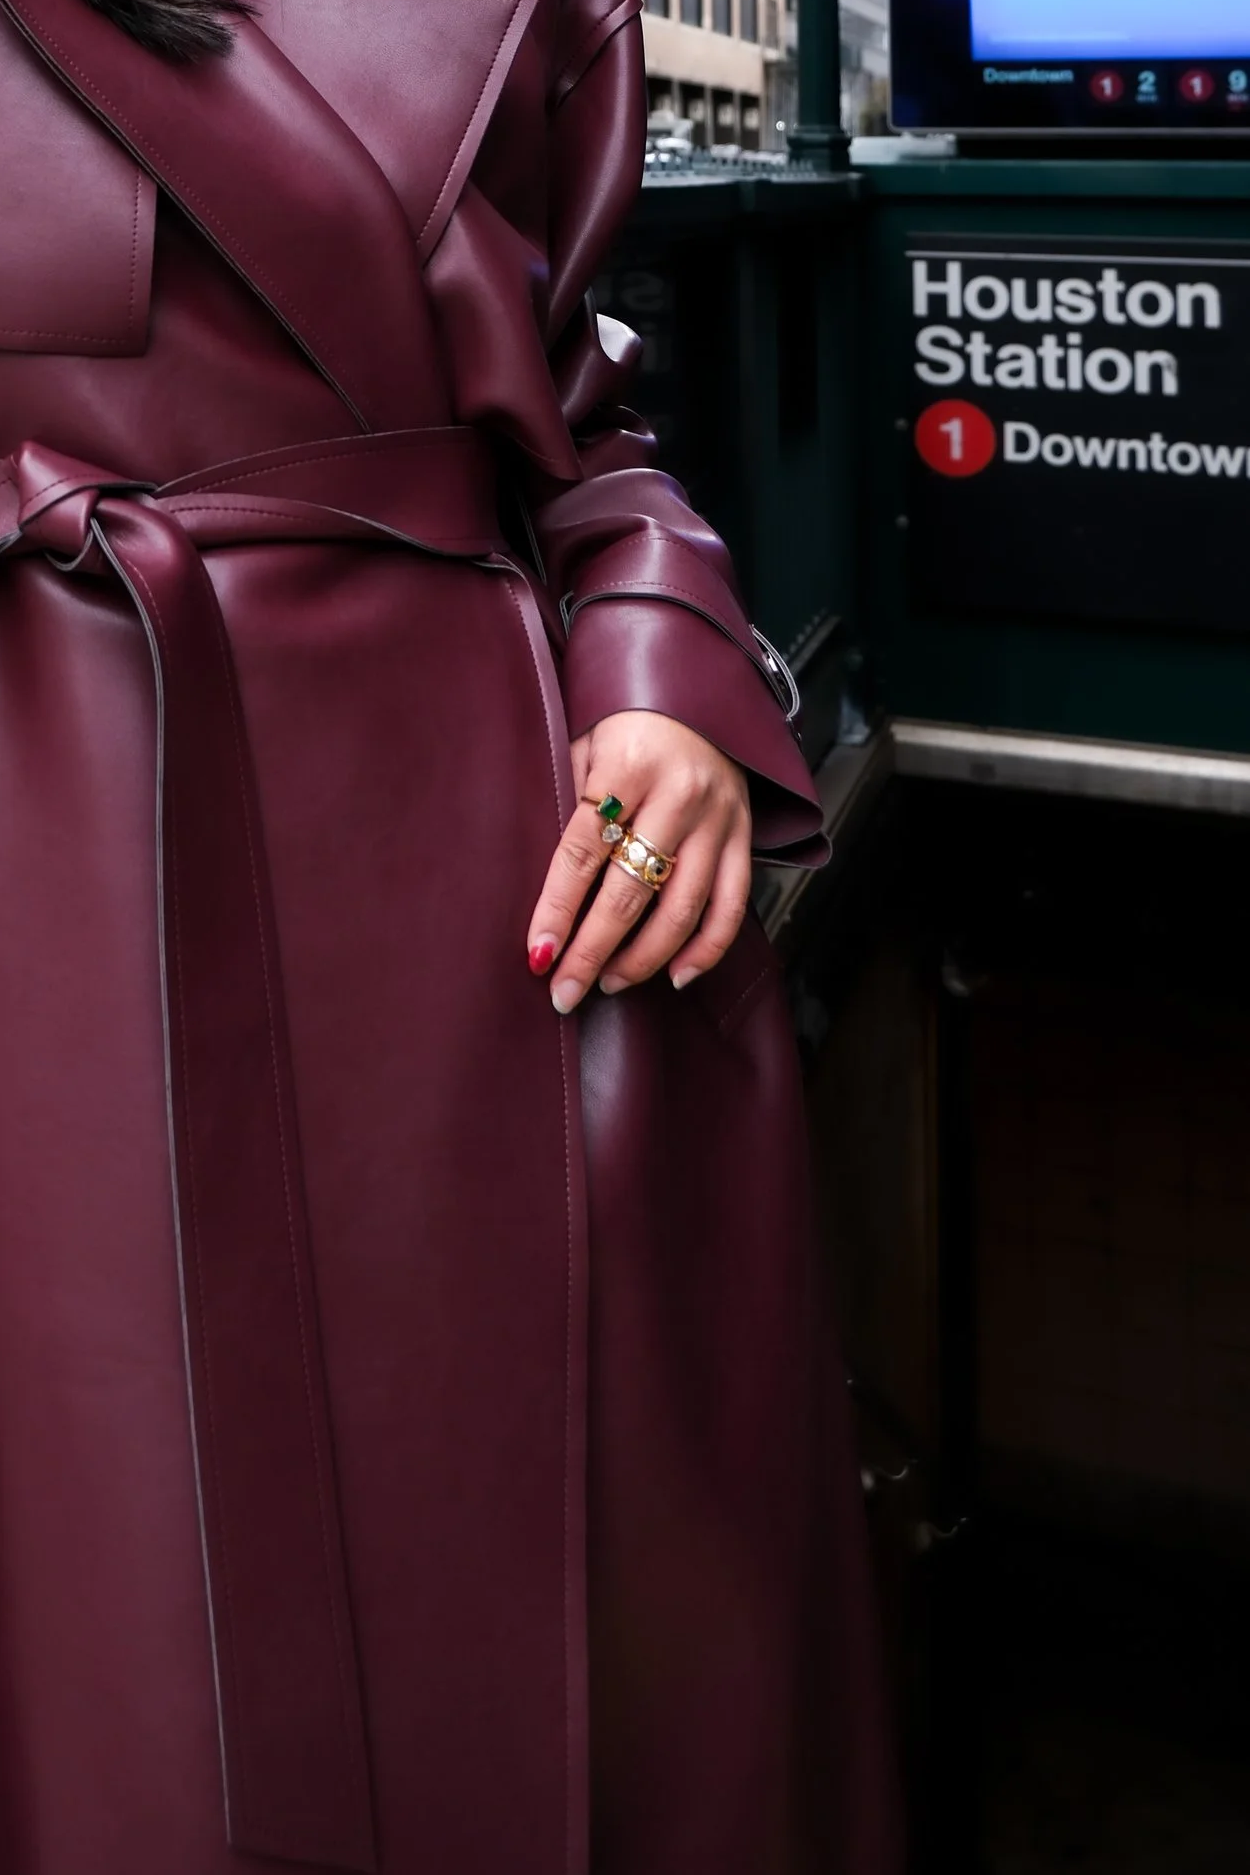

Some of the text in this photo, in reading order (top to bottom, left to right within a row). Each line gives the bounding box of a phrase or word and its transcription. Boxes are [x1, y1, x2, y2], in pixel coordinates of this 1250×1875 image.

[983, 67, 1074, 84] Downtown
[1137, 70, 1156, 92] 2
[1228, 69, 1247, 93] 9
[912, 260, 1221, 329] Houston
[913, 324, 1179, 396] Station
[939, 417, 1250, 479] 1 Downtow
